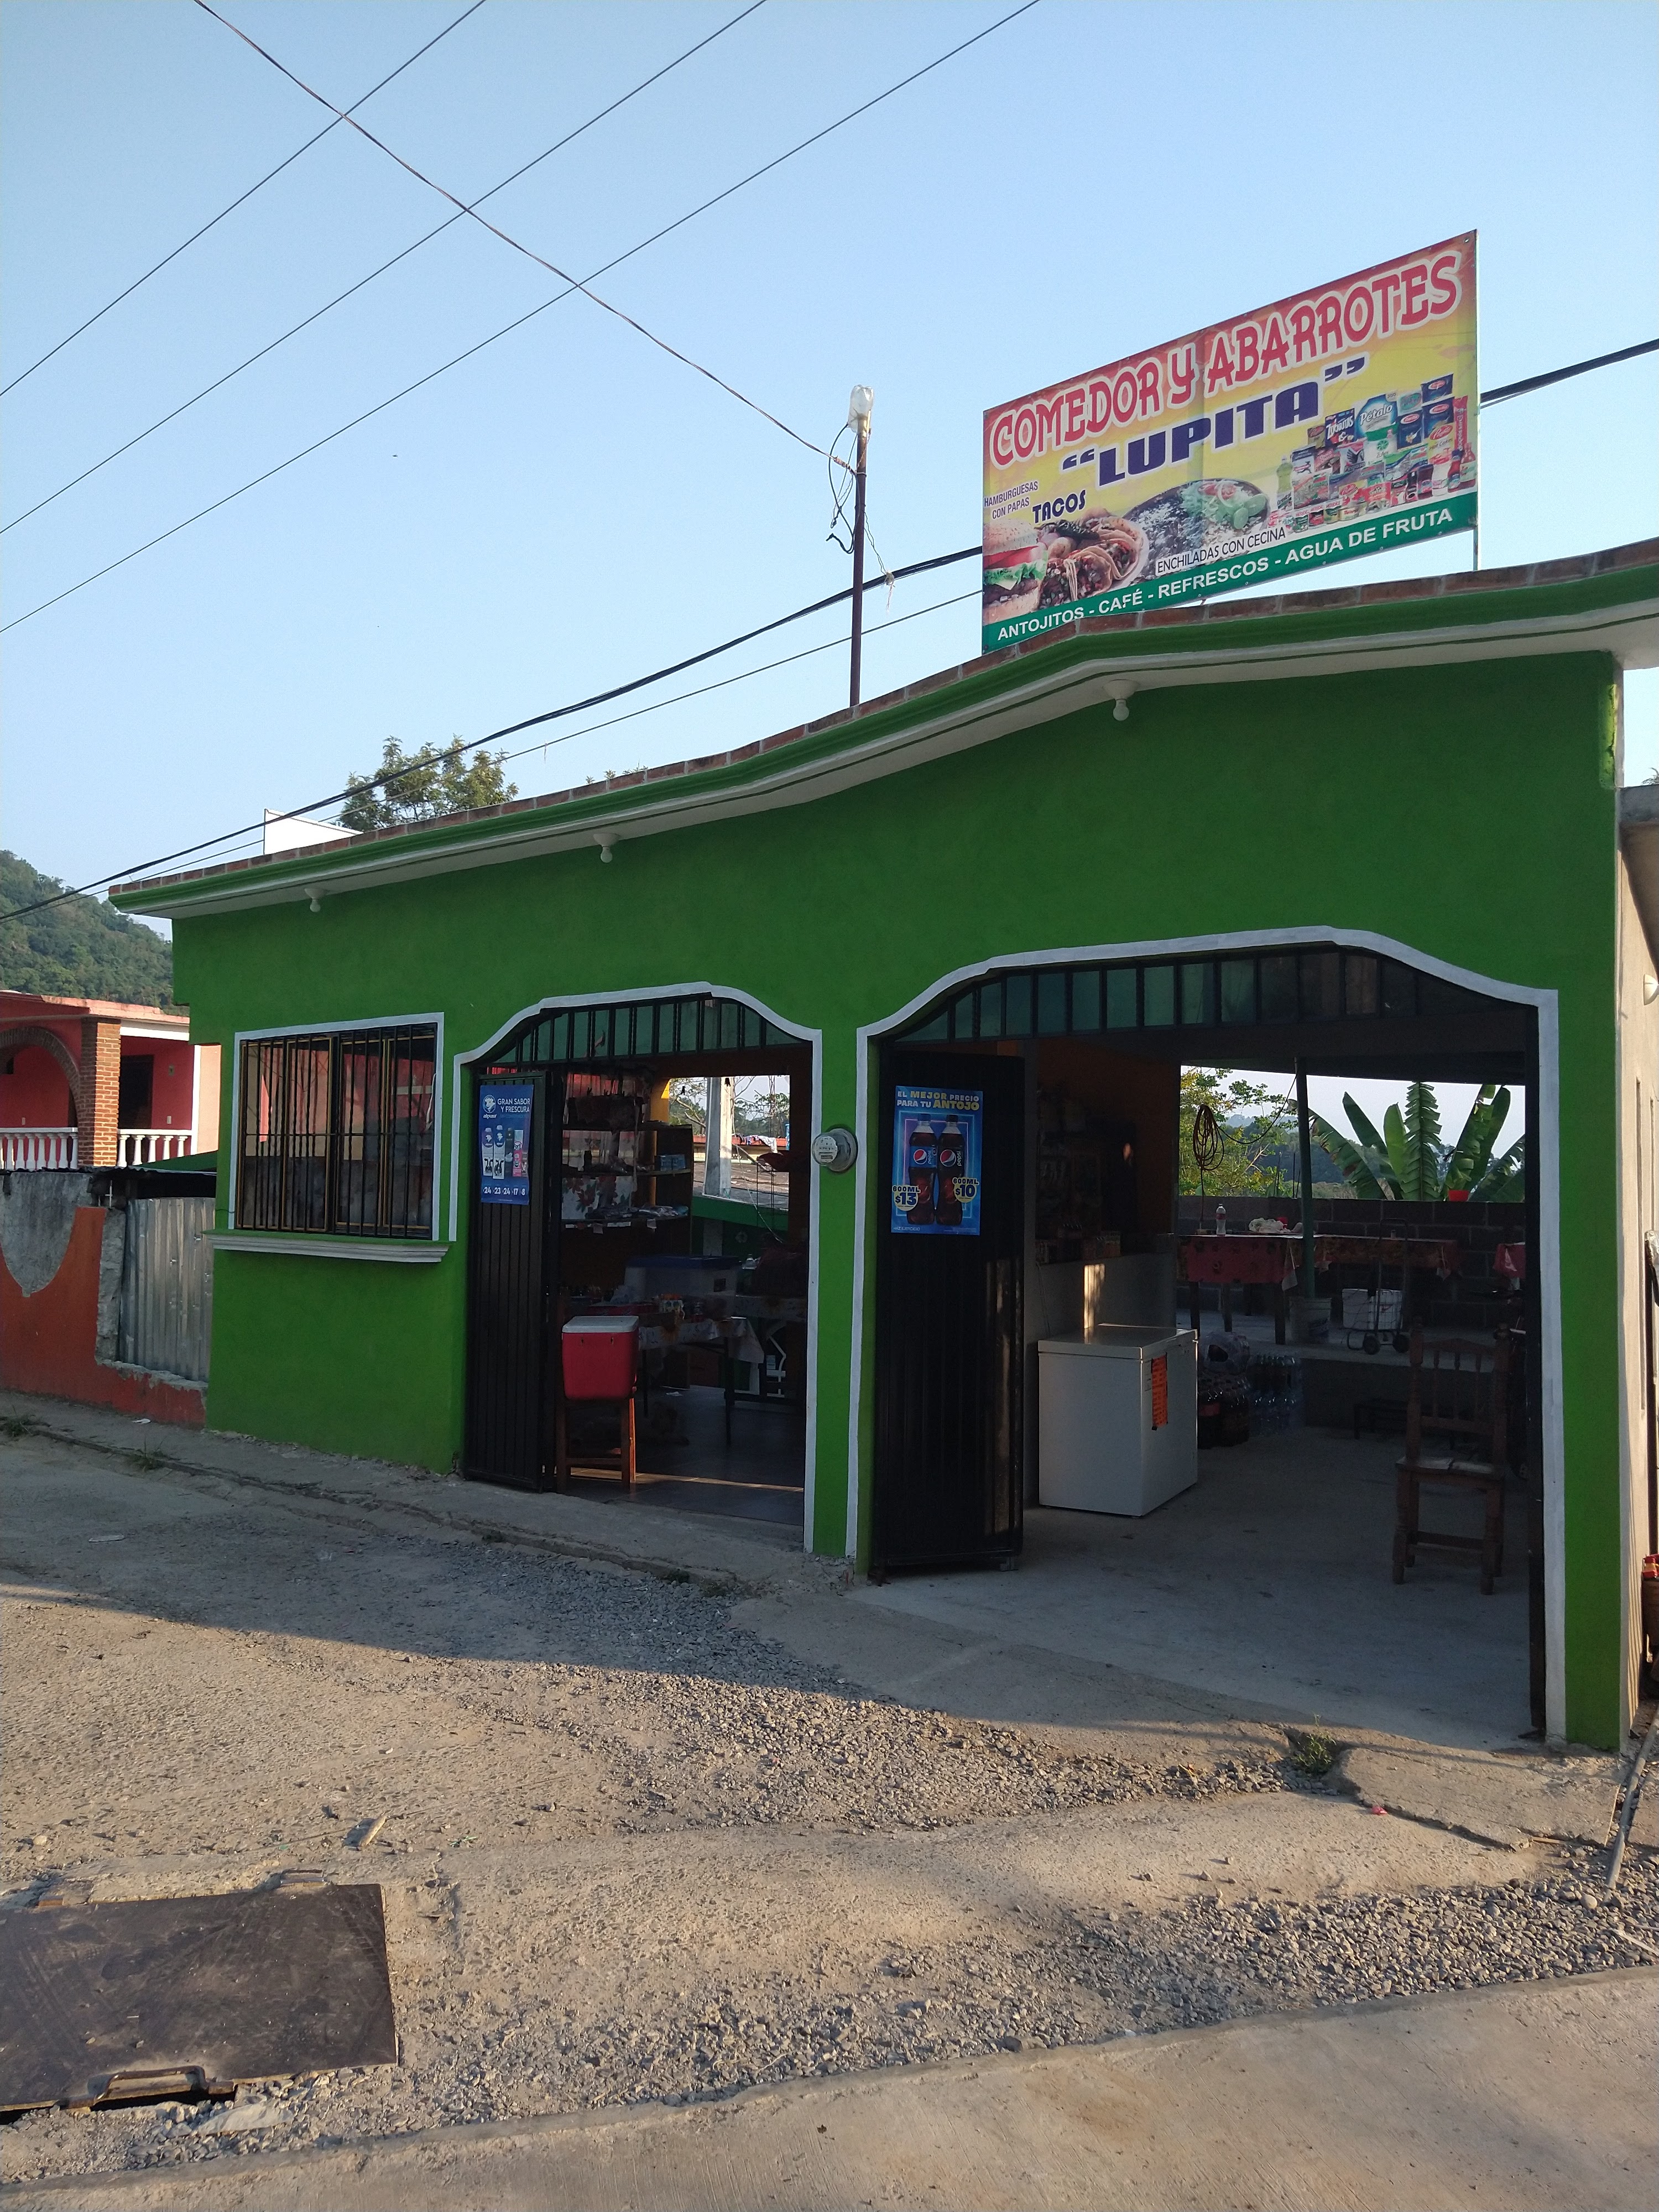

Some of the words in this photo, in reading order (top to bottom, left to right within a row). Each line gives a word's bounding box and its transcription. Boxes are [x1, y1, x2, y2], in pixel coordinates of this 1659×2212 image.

[993, 361, 1161, 466] COMEDOR
[1169, 347, 1196, 405] Y
[1207, 255, 1458, 394] ABARROTES
[1359, 403, 1393, 426] Pétalo
[984, 481, 1039, 507] HAMBURGUESAS
[992, 508, 1006, 519] CON
[1007, 497, 1030, 514] PAPAS
[1032, 489, 1086, 524] TACOS
[1157, 545, 1219, 573] ENCHILADAS
[1222, 538, 1245, 556] CON
[1247, 526, 1286, 548] CECINA
[997, 606, 1084, 641] ANTOJITOS
[1098, 588, 1143, 614] CAFÉ
[1158, 557, 1269, 599] REFRESCOS
[1285, 536, 1344, 565] AGUA
[1348, 526, 1376, 548] DE
[1383, 508, 1453, 539] FRUTA
[910, 1091, 947, 1100] MEJOR
[949, 1094, 980, 1102] PRECIO
[932, 1099, 980, 1111] ANTOJO
[895, 1192, 917, 1206] $13
[955, 1184, 975, 1198] $10
